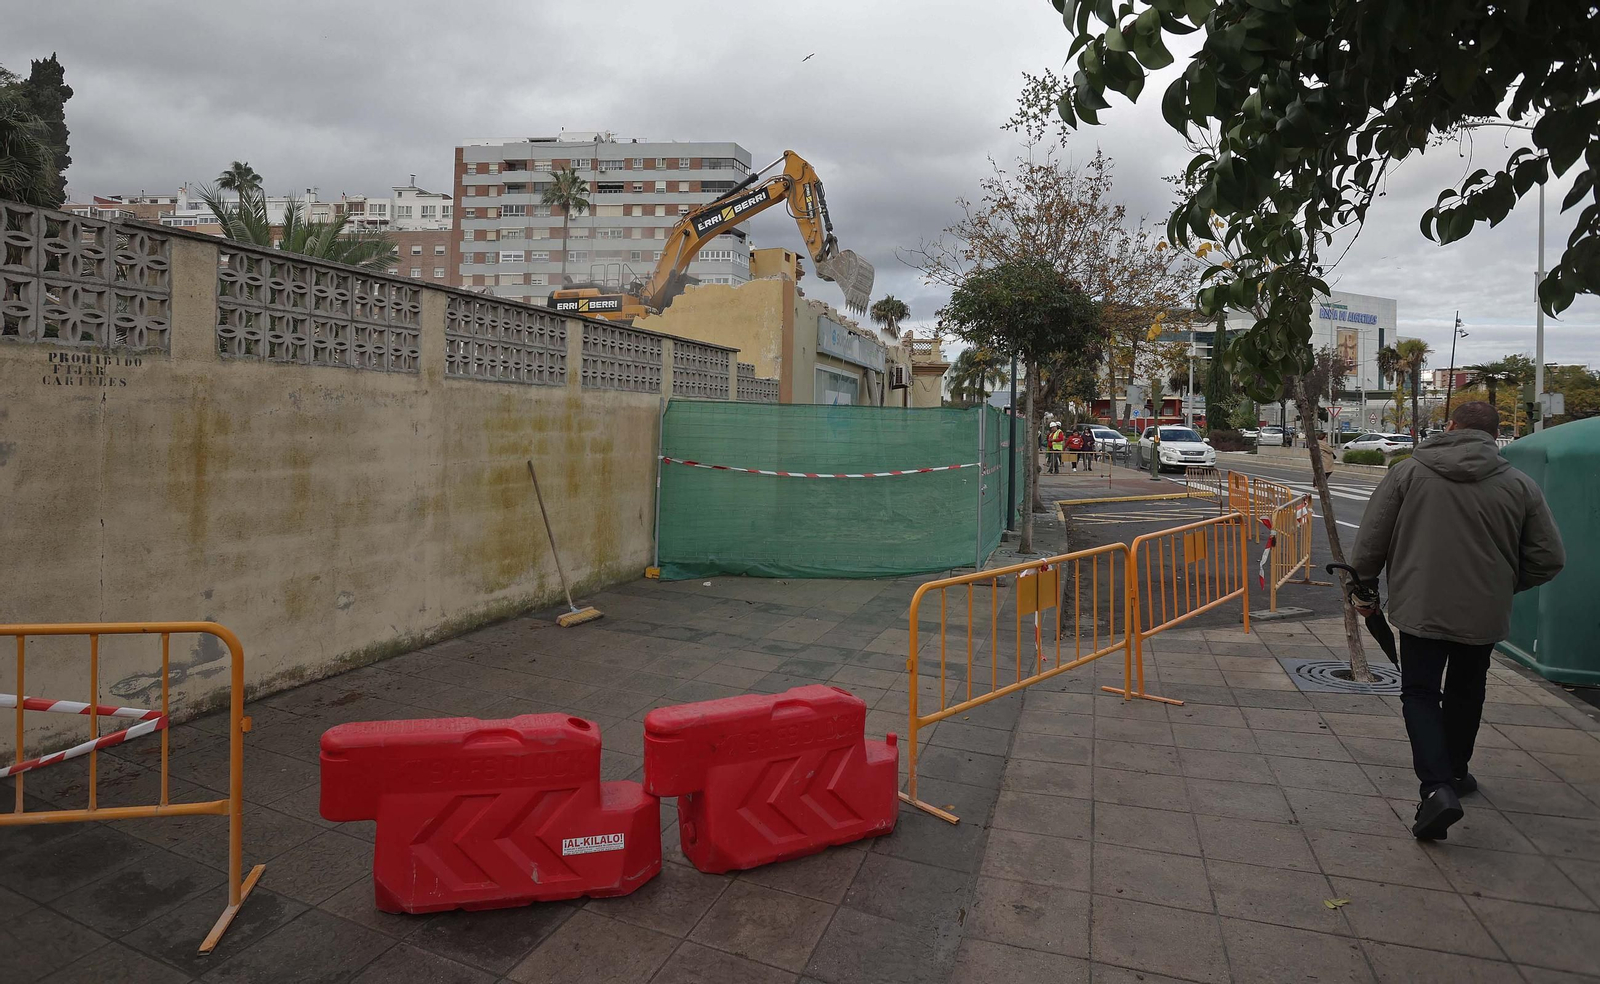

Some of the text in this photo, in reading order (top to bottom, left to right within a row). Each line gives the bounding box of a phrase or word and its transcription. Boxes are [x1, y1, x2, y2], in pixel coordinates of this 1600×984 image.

[697, 191, 767, 231] ERRI BERRI
[557, 300, 617, 310] ERRI BERRI
[48, 352, 142, 367] PROHIBIDO
[53, 364, 105, 376] FIJAR
[42, 375, 127, 387] CARTELES
